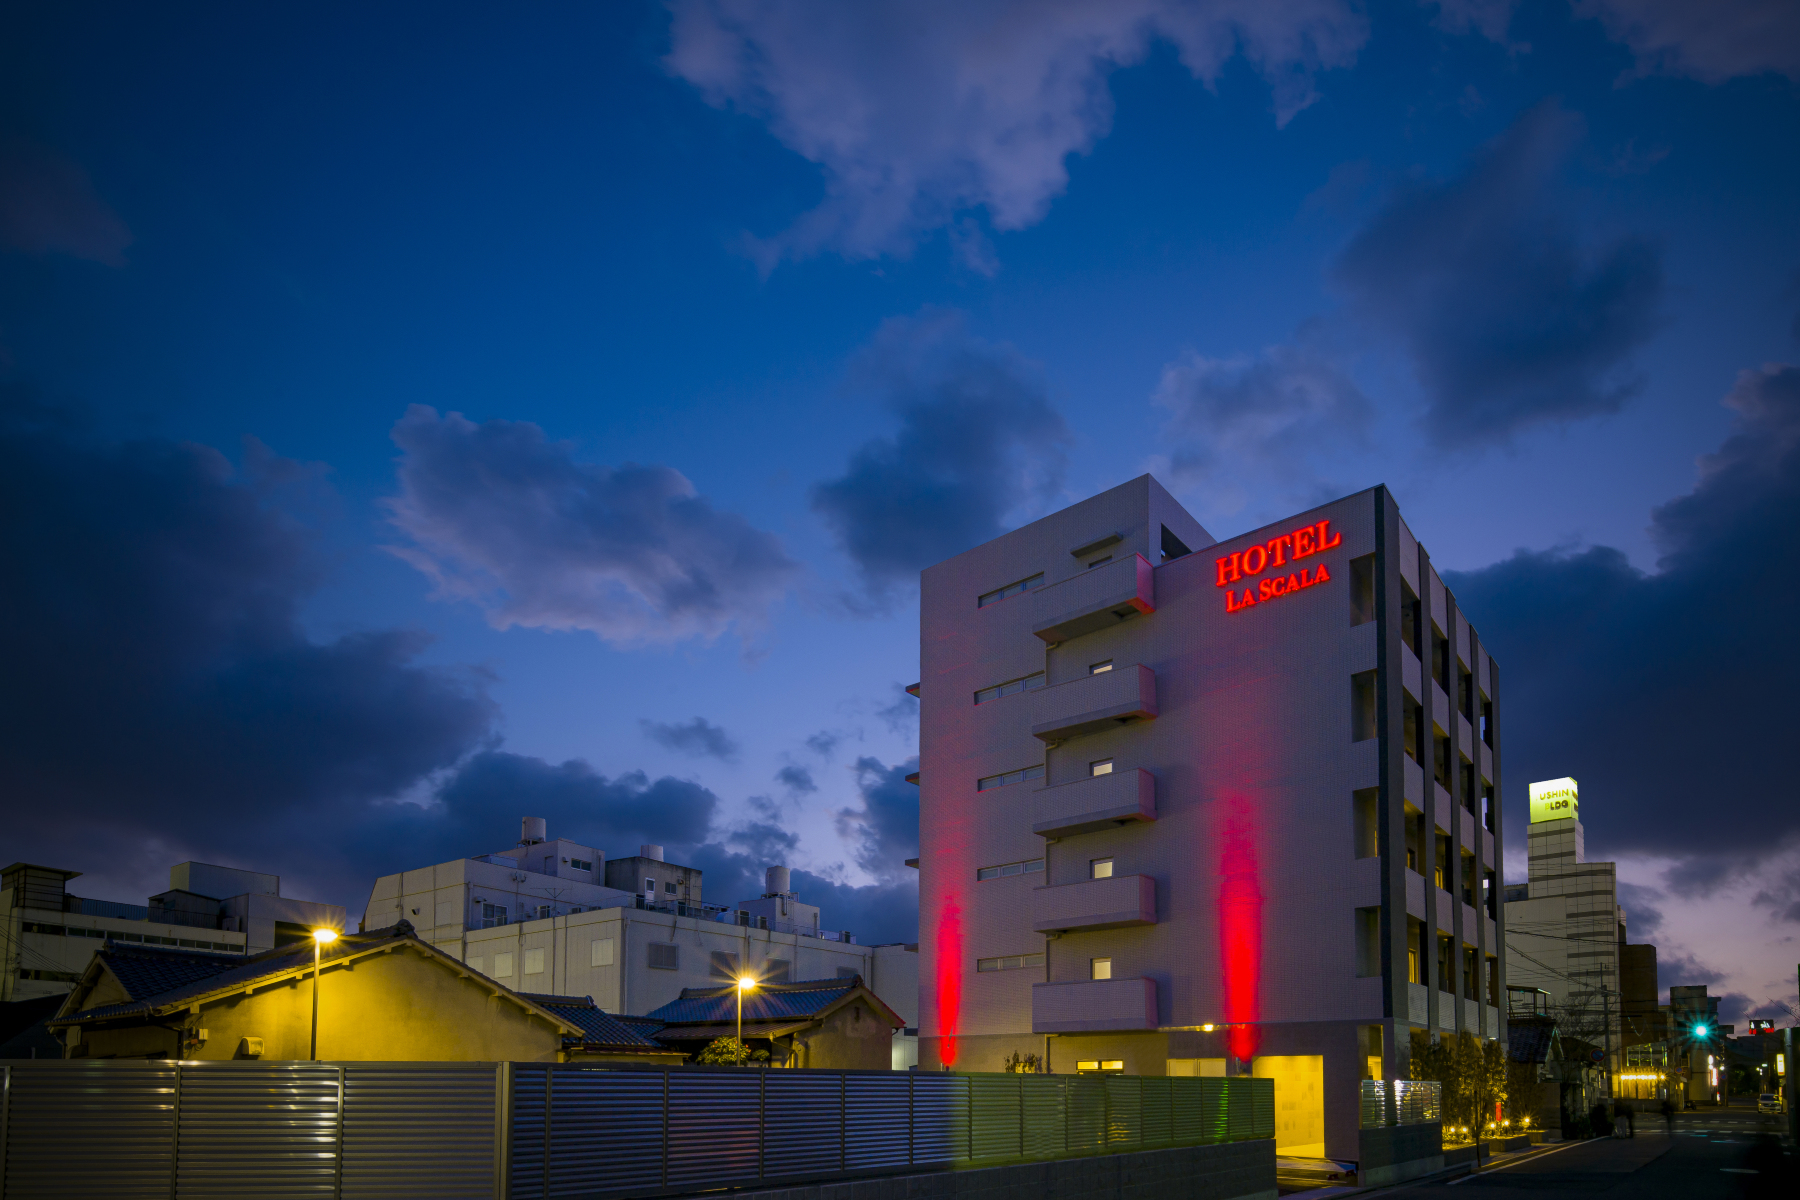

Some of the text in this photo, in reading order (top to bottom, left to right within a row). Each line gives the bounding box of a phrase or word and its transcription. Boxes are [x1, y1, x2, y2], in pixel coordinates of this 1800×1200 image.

[1216, 520, 1341, 586] HOTEL
[1226, 563, 1330, 612] LA SCALA
[1540, 788, 1569, 800] USHIN
